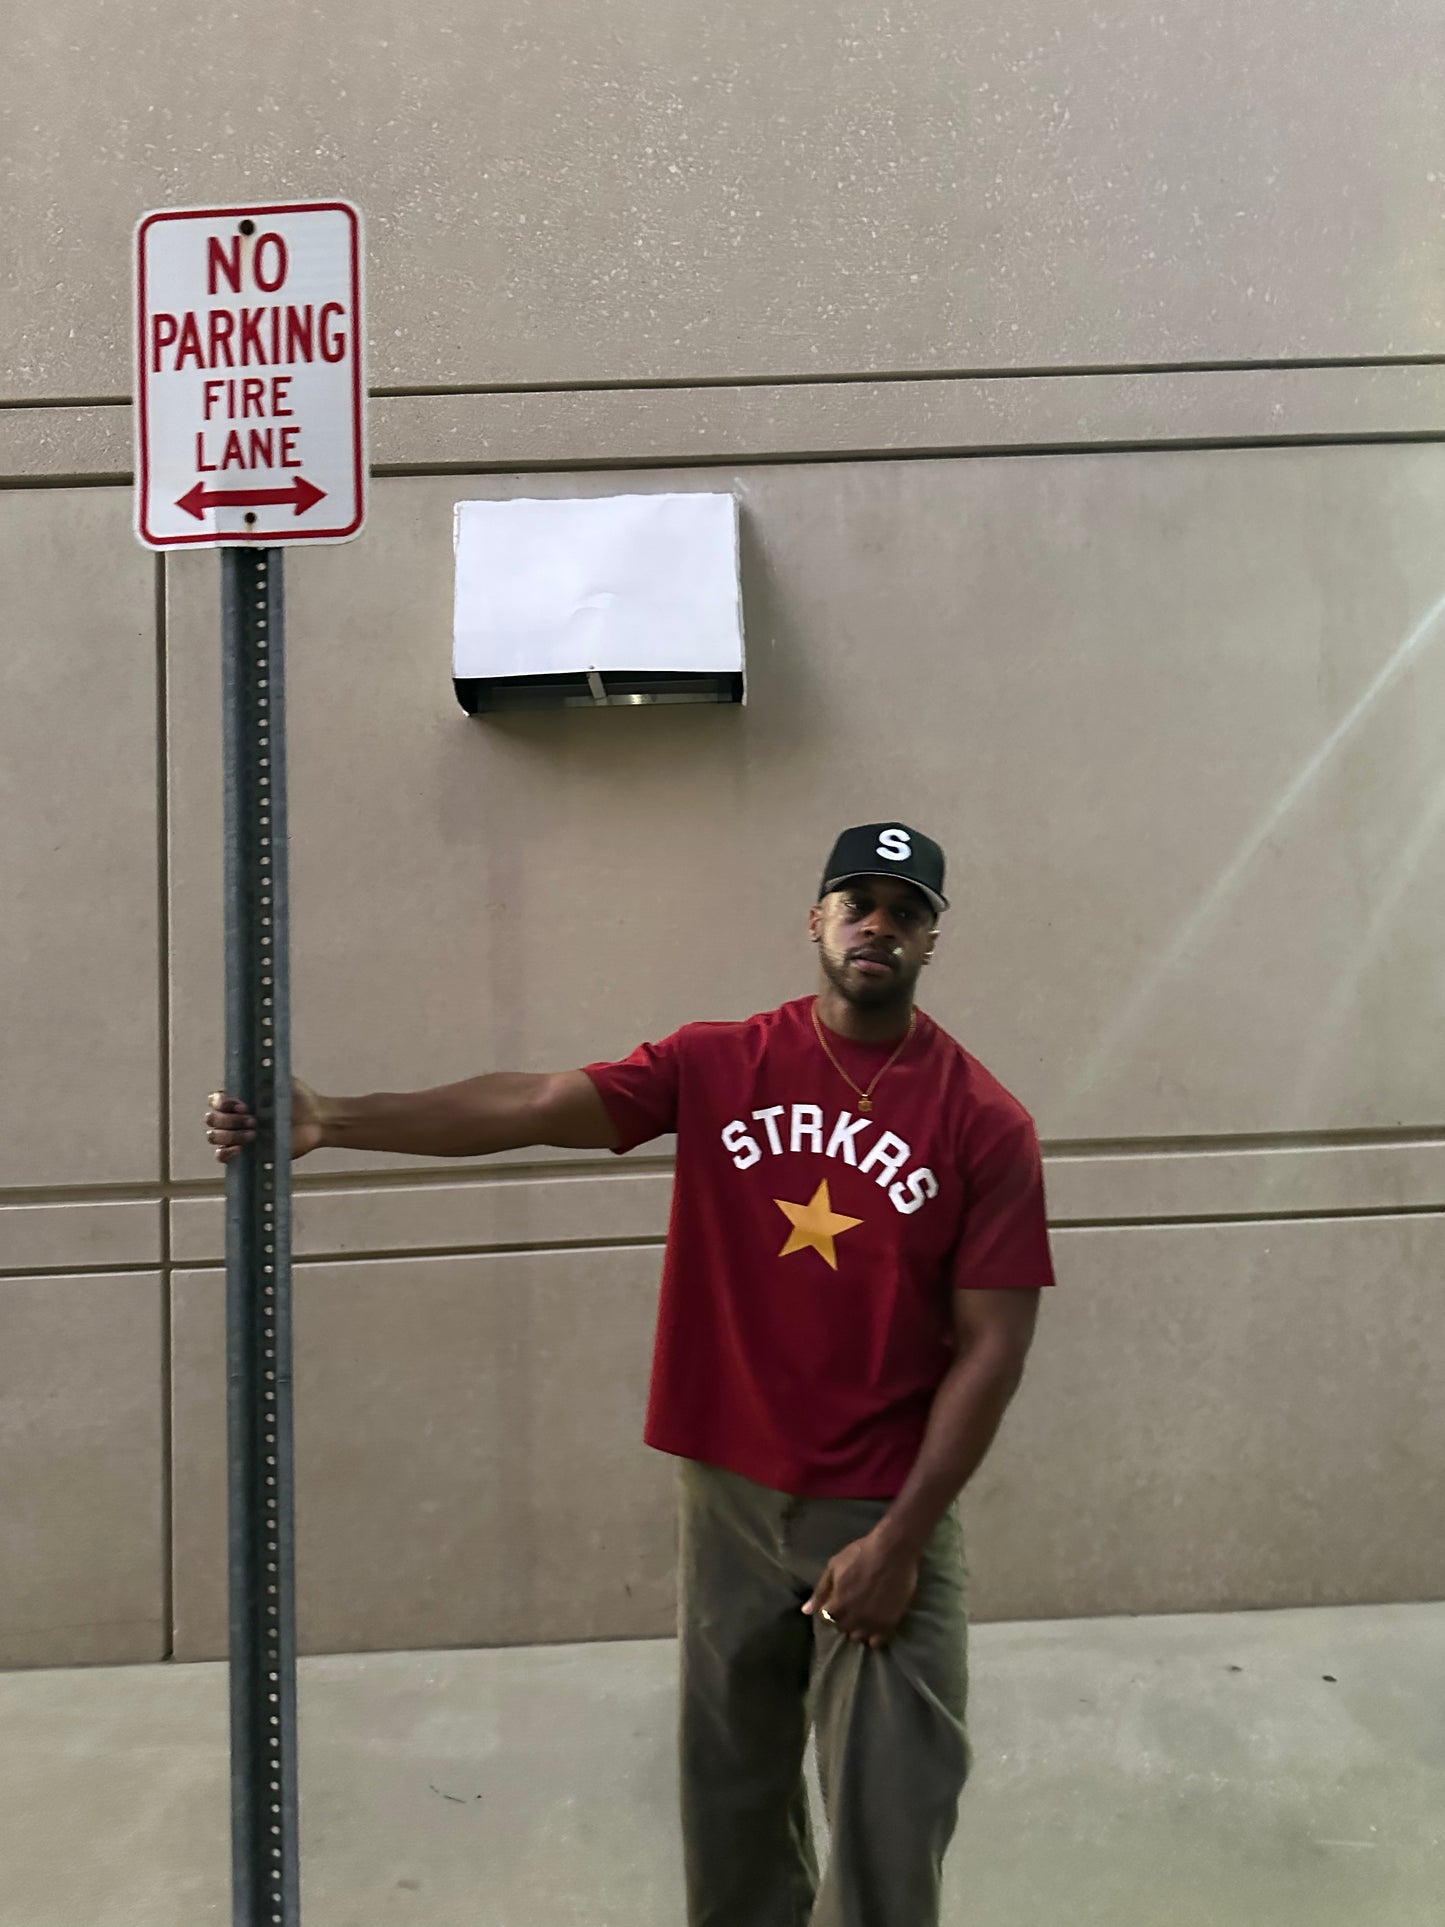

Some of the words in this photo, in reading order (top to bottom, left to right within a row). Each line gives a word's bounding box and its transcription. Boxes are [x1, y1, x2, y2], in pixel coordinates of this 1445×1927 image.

[207, 232, 288, 295] NO
[151, 302, 346, 372] PARKING
[203, 376, 294, 420] FIRE
[196, 427, 303, 472] LANE
[876, 828, 912, 861] S
[721, 1103, 940, 1215] STRKRS
